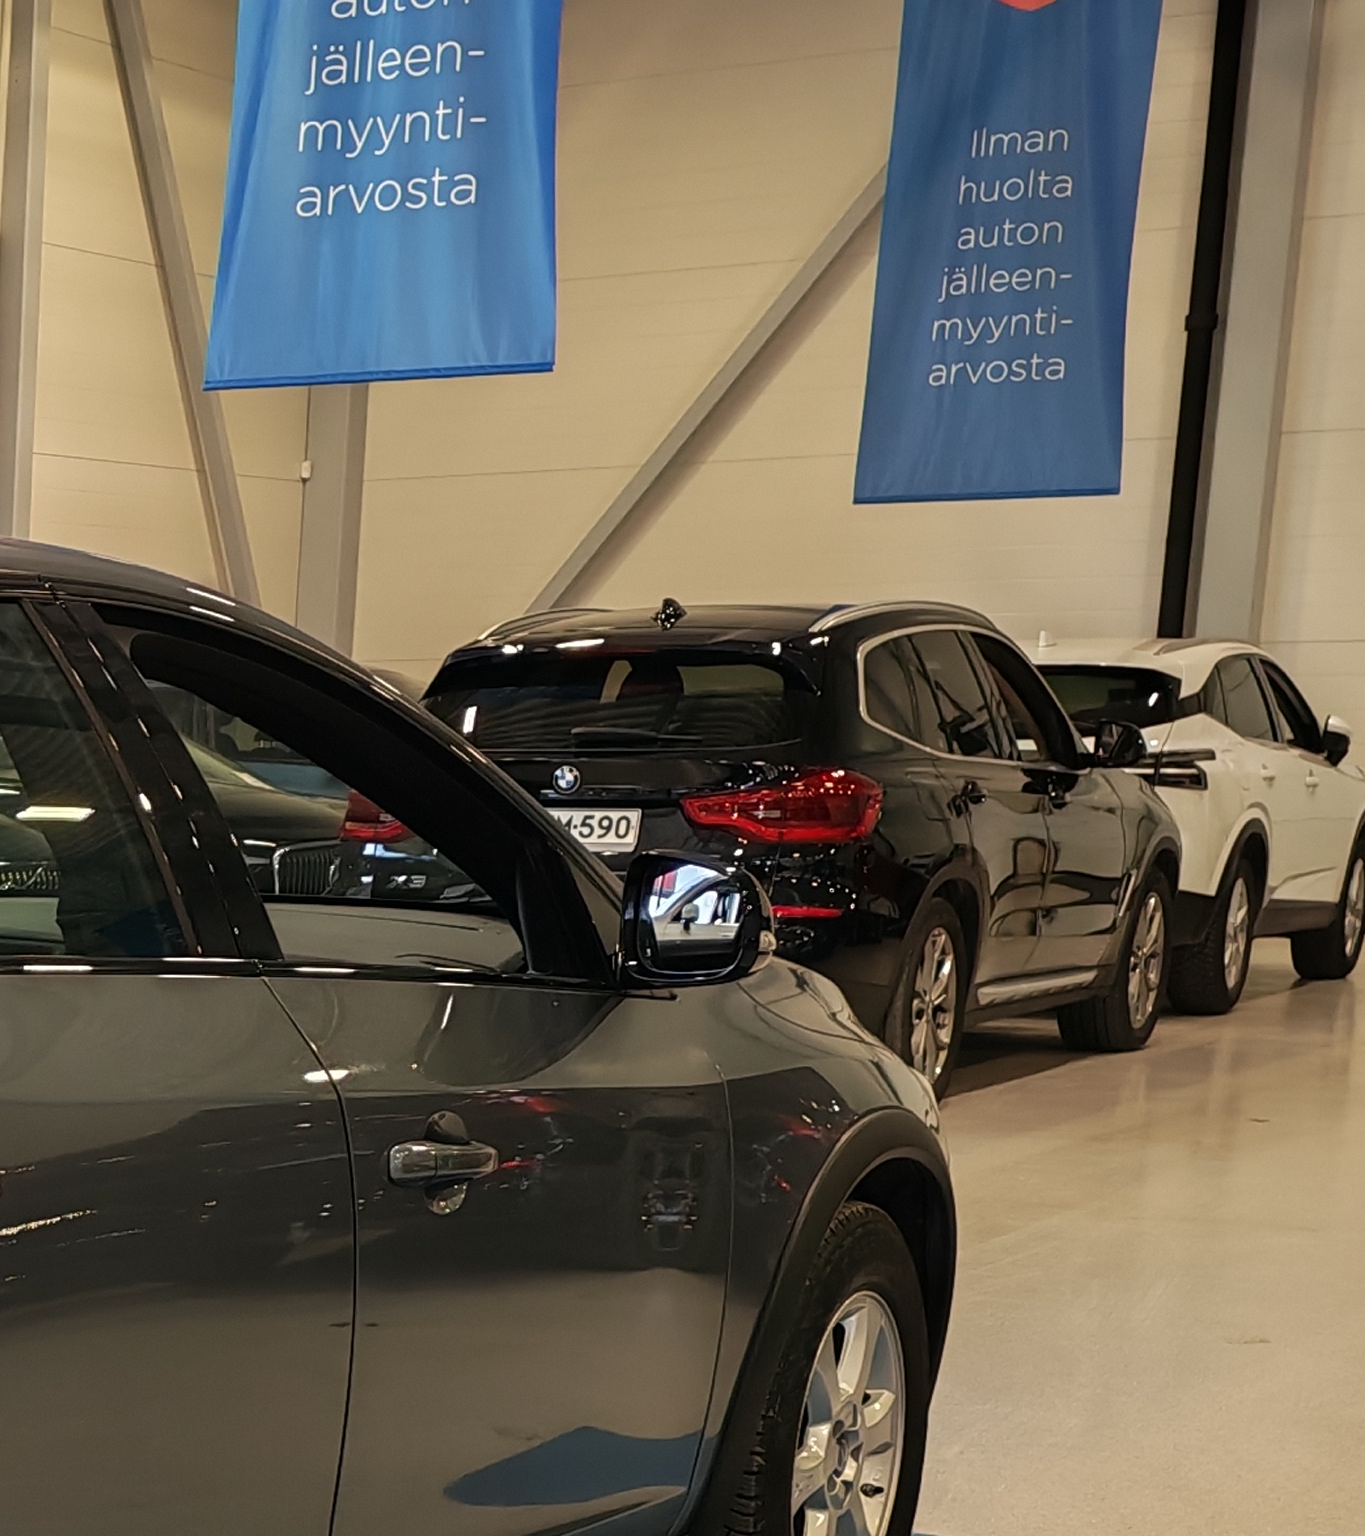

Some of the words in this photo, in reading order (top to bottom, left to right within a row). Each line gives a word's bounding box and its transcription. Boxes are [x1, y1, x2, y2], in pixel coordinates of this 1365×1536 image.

[304, 38, 485, 95] jälleen-
[298, 96, 487, 158] myynti-
[971, 126, 1069, 158] Ilman
[295, 167, 477, 217] arvosta
[958, 168, 1073, 205] huolta
[957, 218, 1063, 250] auton
[937, 263, 1073, 303] jälleen-
[931, 305, 1074, 345] myynti-
[927, 352, 1066, 387] arvosta
